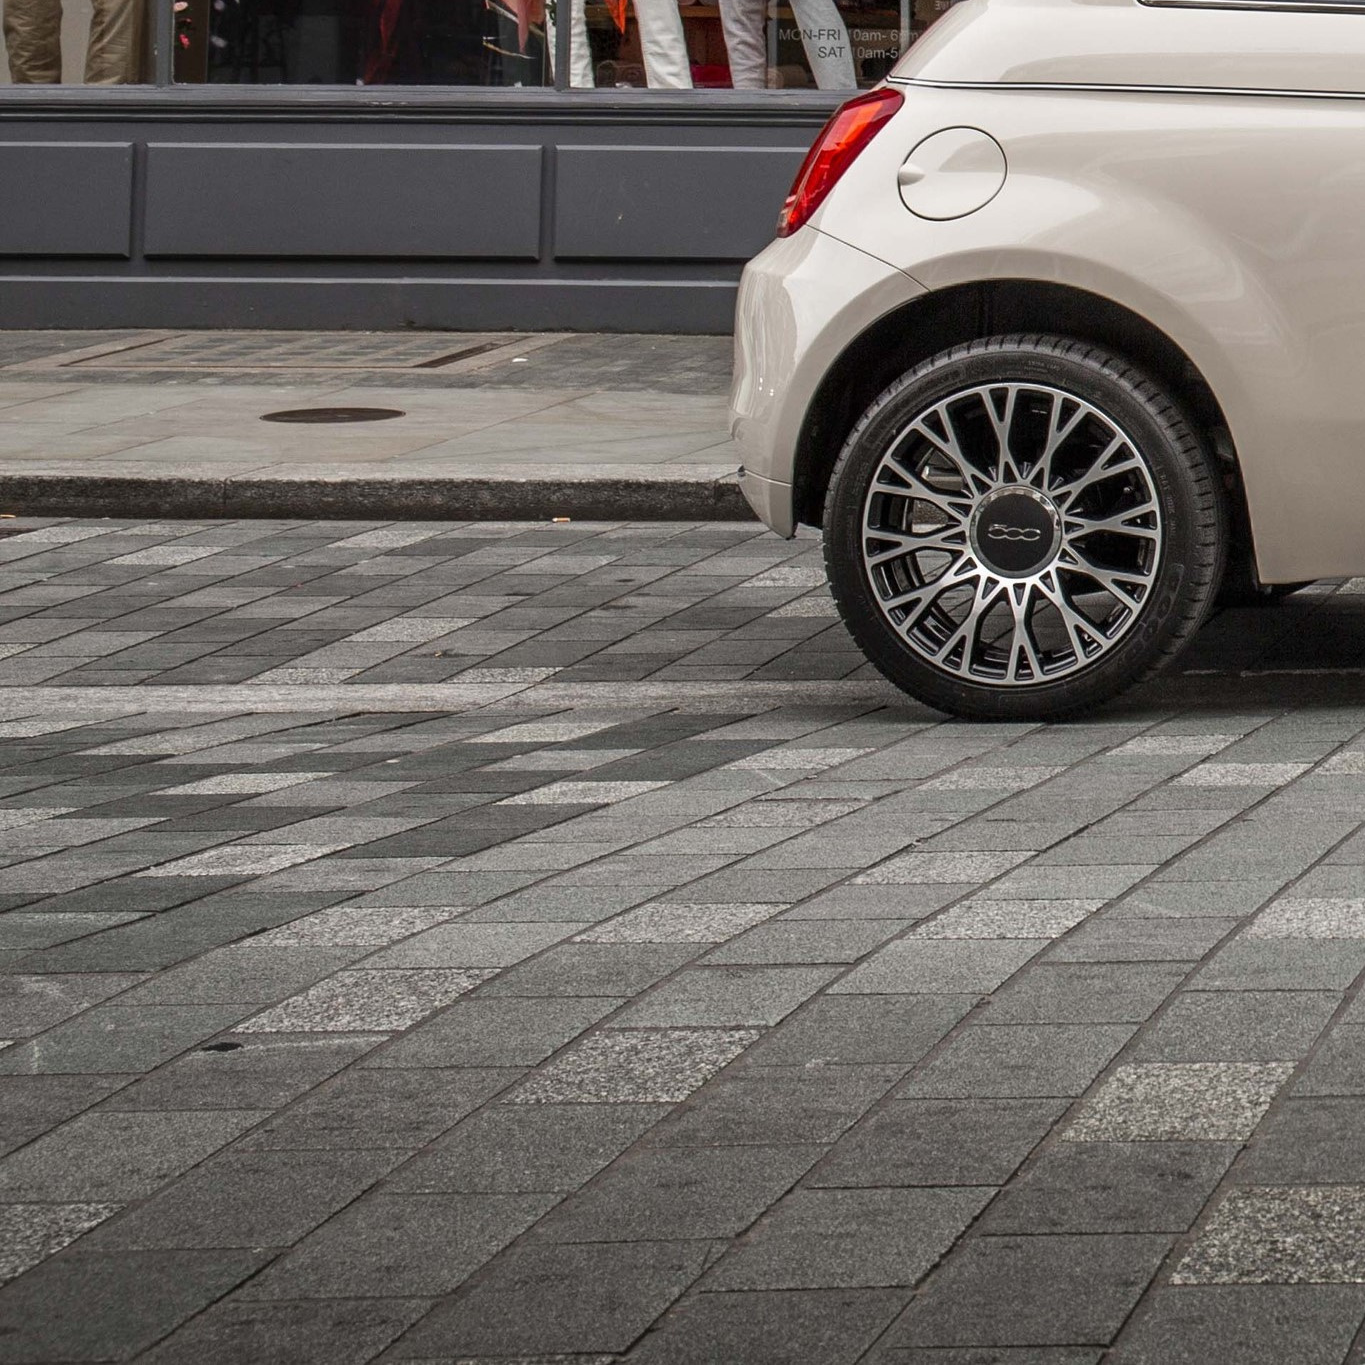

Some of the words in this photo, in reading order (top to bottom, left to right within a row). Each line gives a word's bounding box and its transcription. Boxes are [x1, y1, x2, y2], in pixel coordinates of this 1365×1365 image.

[779, 29, 841, 41] MON-FRI
[818, 46, 846, 58] SAT
[988, 524, 1041, 541] 500
